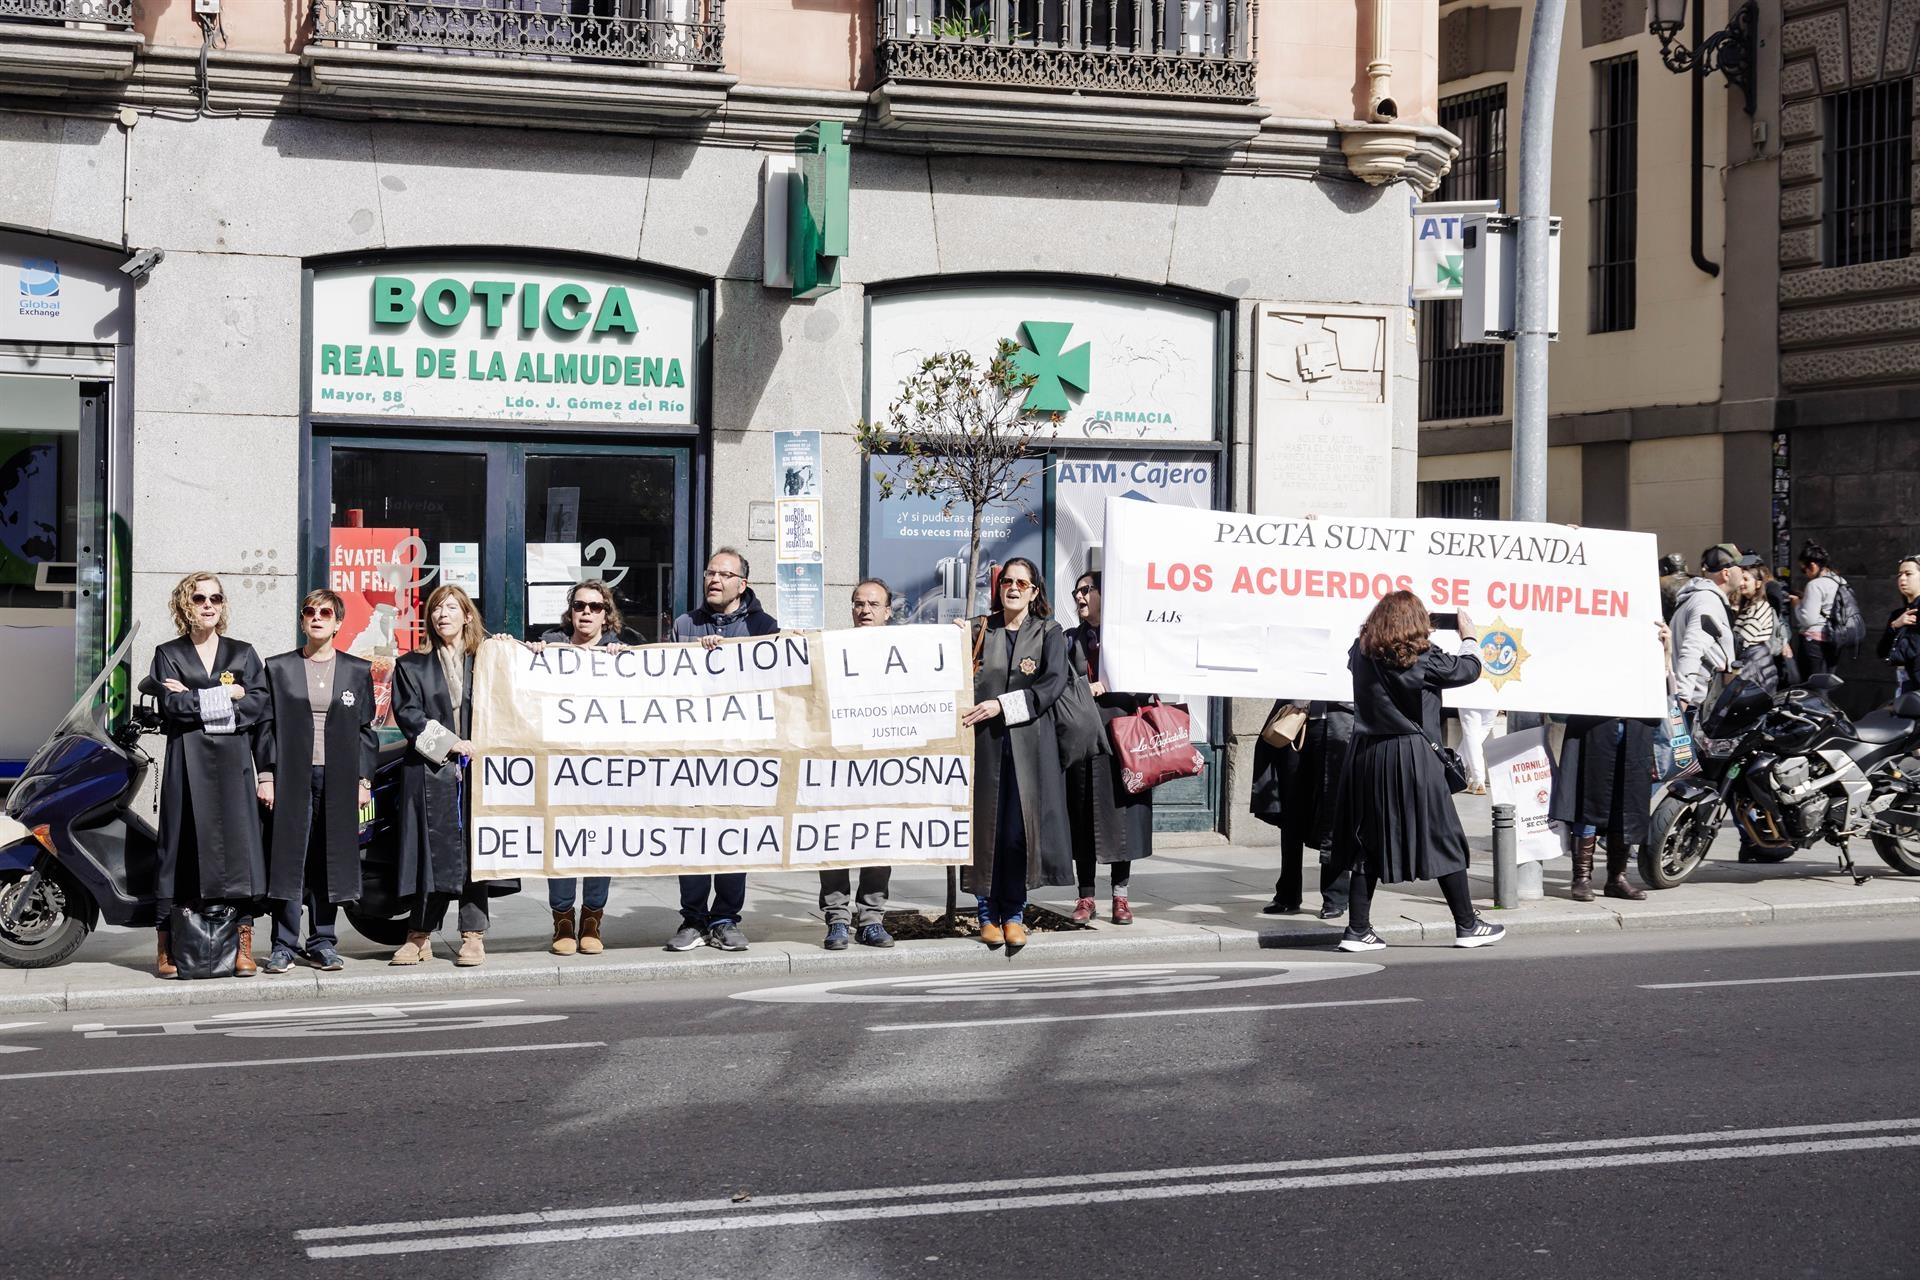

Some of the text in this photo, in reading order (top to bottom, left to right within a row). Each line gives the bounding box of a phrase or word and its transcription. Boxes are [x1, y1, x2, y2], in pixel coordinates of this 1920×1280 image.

[1419, 217, 1464, 240] AT
[20, 299, 60, 309] Global
[20, 308, 60, 317] Exchange
[374, 276, 639, 333] BOTICA
[321, 344, 685, 387] REAL DE LA ALMUDENA
[321, 388, 403, 403] Mayor, 88
[505, 396, 684, 412] Ldo. J. Gómez del Río
[1096, 410, 1172, 424] FARMACIA
[1058, 461, 1208, 488] ATM Cajero
[912, 512, 919, 522] si
[967, 513, 1015, 526] evejecer
[900, 526, 919, 536] dos
[921, 529, 951, 537] veces
[979, 529, 1012, 538] ento?
[1213, 522, 1588, 566] PACTA SUNT SERVANDA
[330, 545, 400, 566] ÉVATELA
[1146, 562, 1214, 593] LOS
[1430, 576, 1470, 606] SE
[1487, 581, 1629, 618] CUMPLEN
[1145, 610, 1182, 625] LAJs
[529, 636, 810, 678] ADECUACIÓN
[558, 693, 775, 725] SALARIAL
[831, 701, 953, 719] LETRADOS ADMÓN DE
[871, 726, 917, 738] JUSTICIA
[484, 756, 969, 788] NO ACEPTAMOS LIMOSNA
[478, 825, 543, 859] DEL
